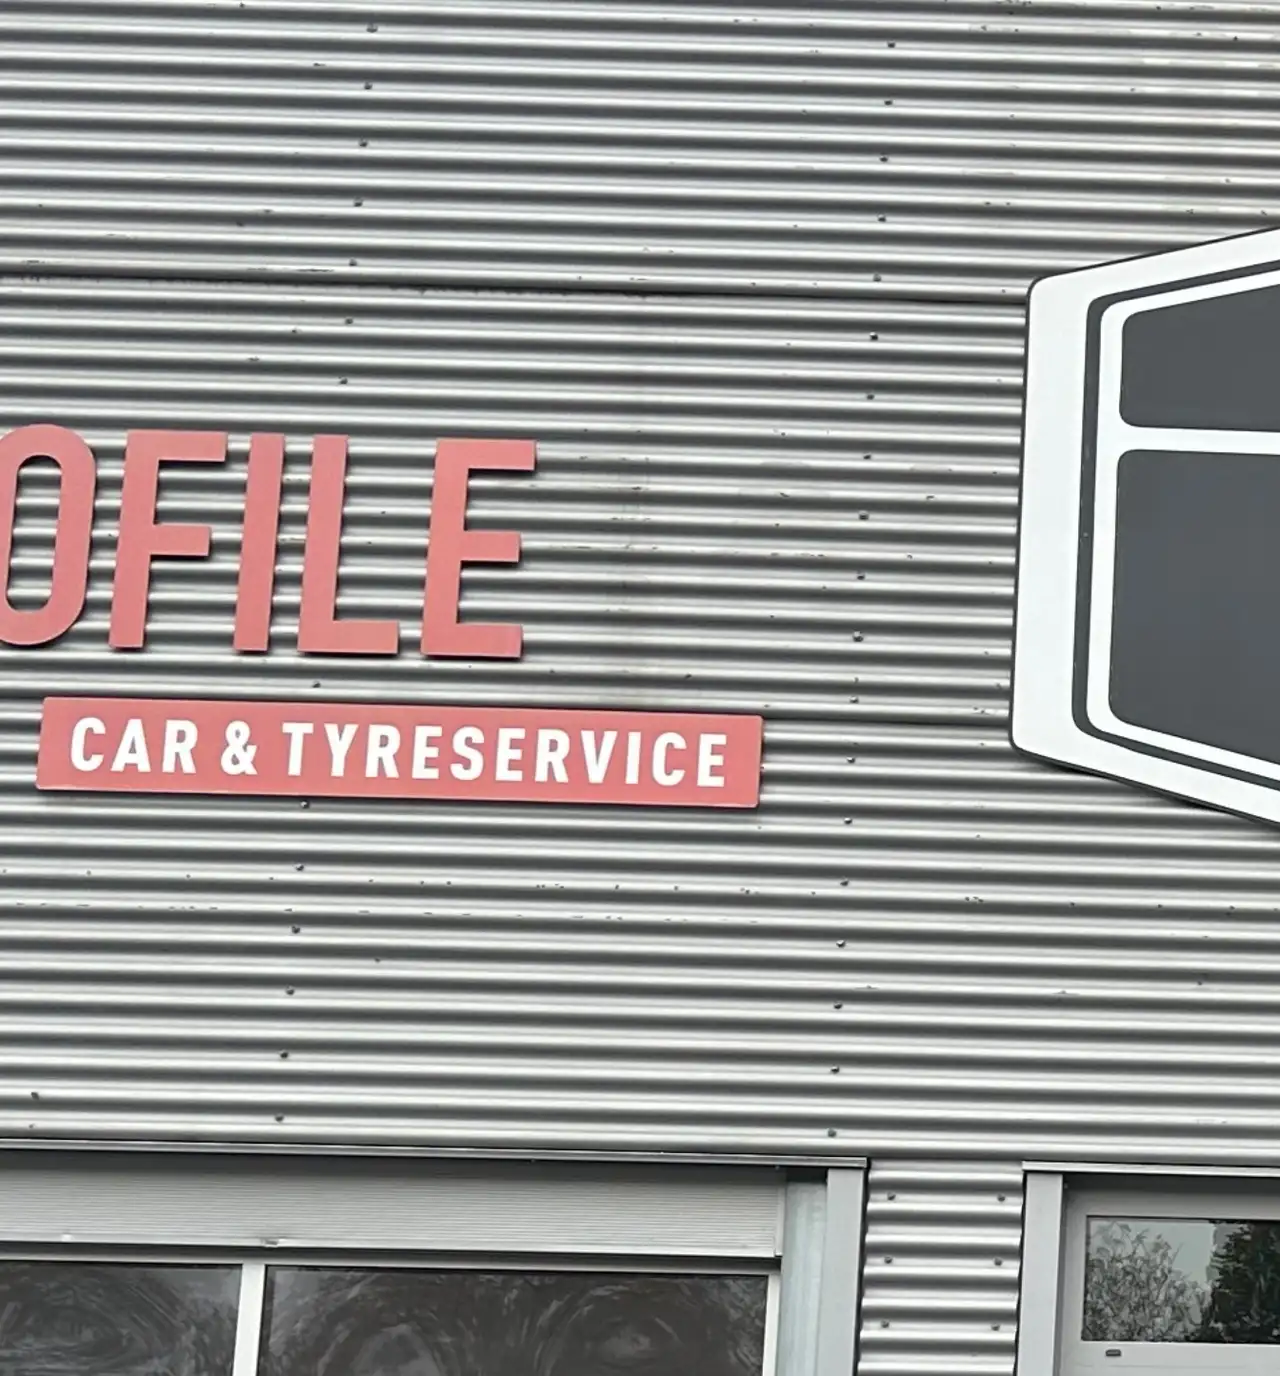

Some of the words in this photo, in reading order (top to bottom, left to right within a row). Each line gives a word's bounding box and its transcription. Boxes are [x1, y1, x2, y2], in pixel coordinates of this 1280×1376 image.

[70, 716, 198, 774] CAR
[220, 720, 258, 775] &
[282, 722, 727, 788] TYRESERVICE
